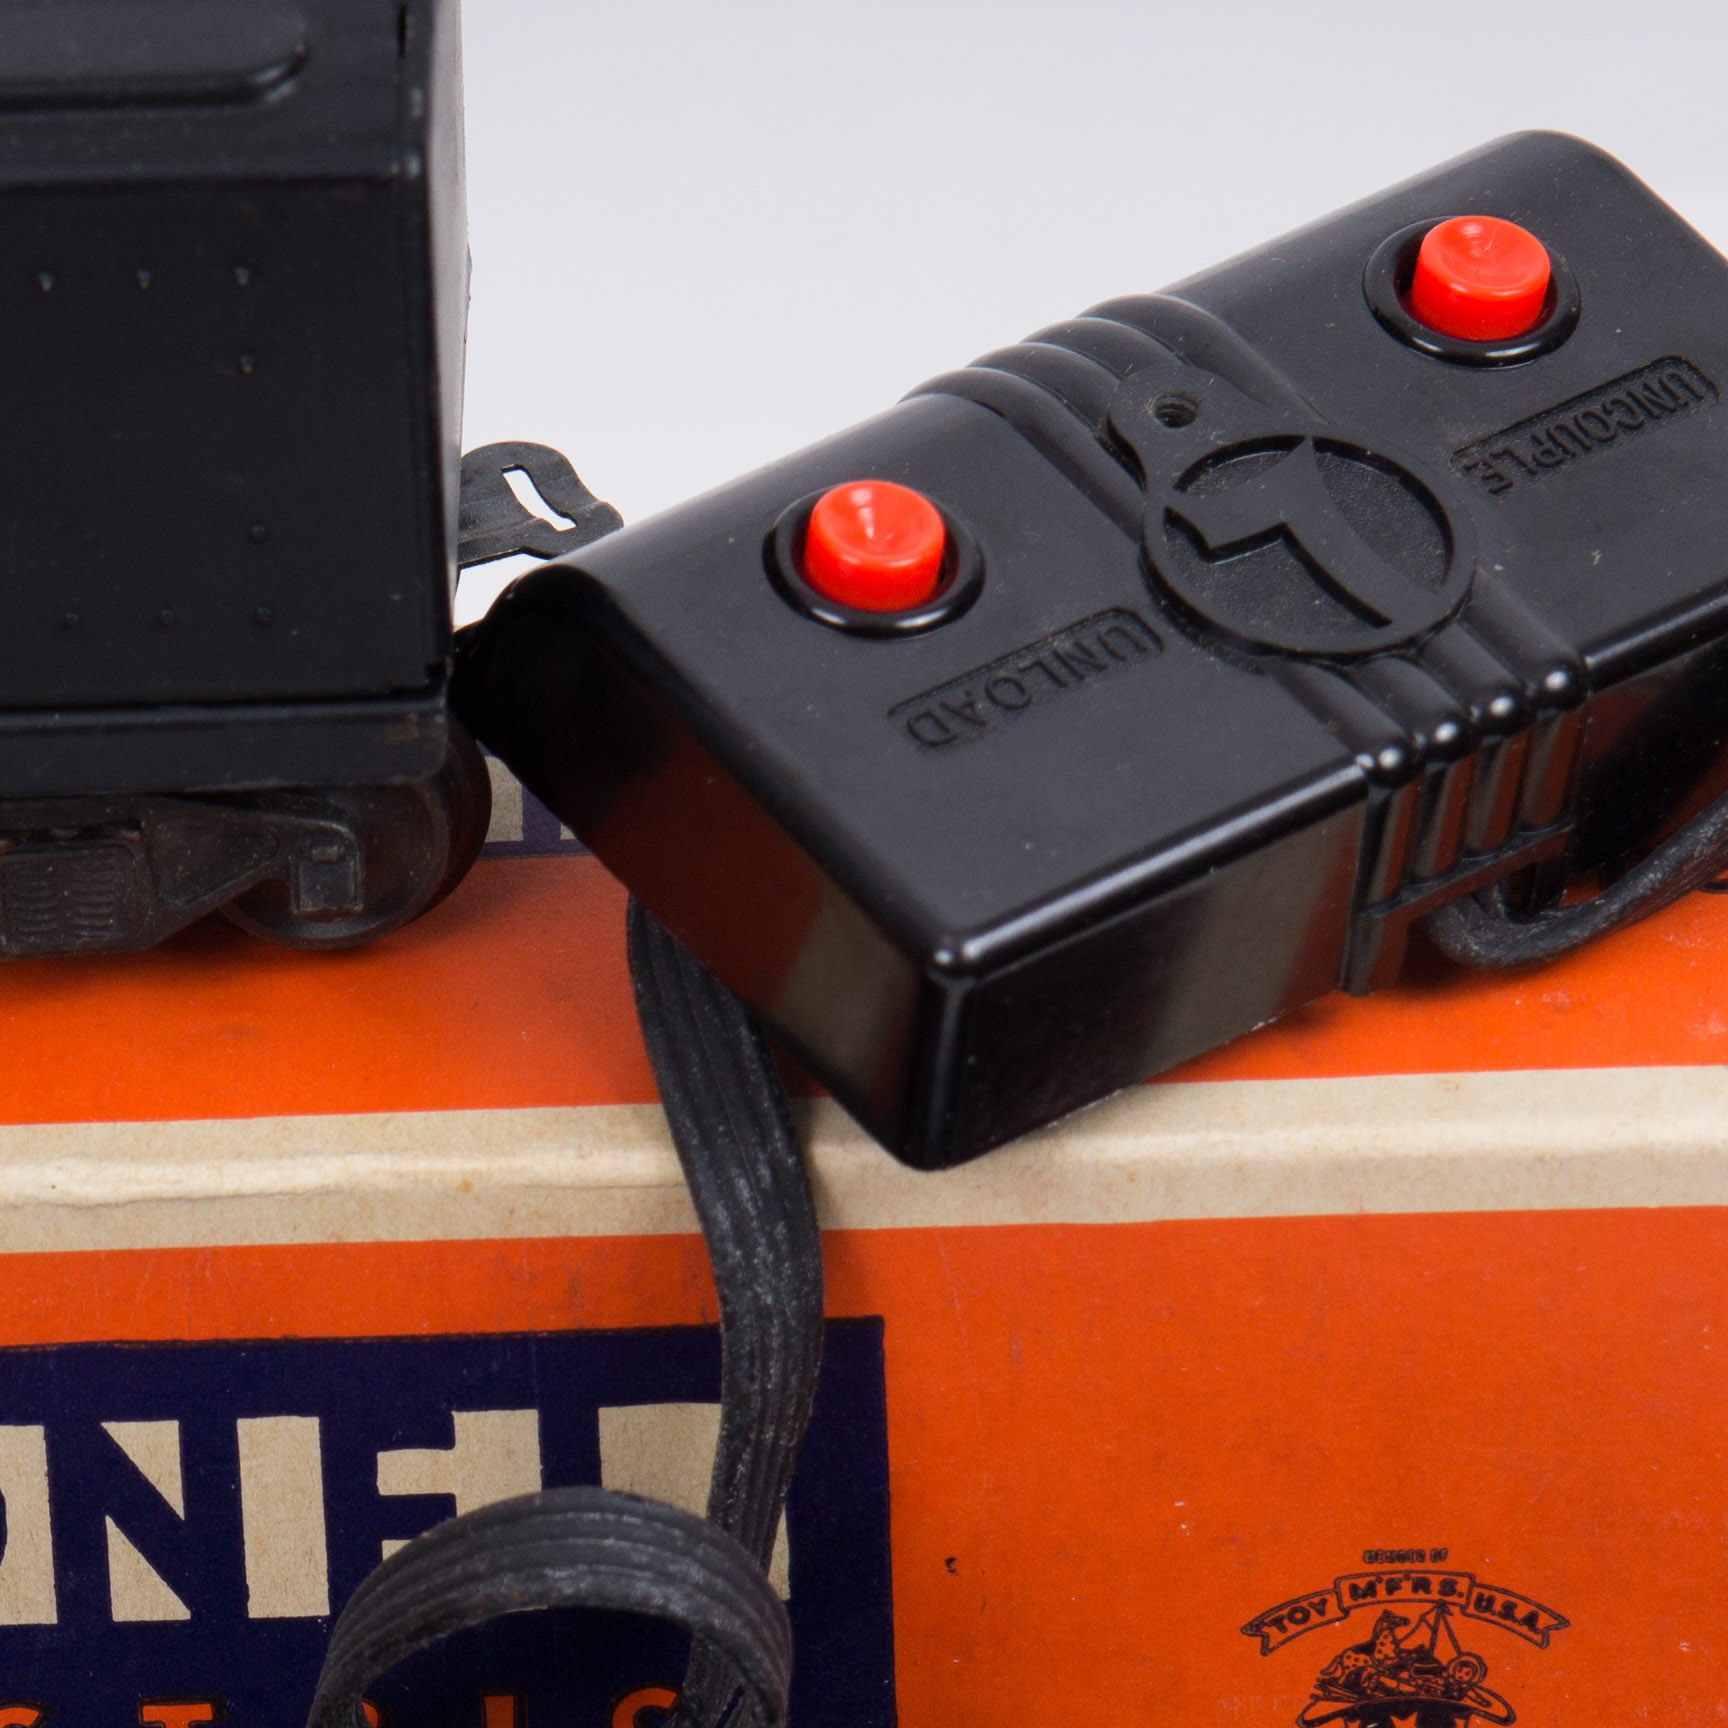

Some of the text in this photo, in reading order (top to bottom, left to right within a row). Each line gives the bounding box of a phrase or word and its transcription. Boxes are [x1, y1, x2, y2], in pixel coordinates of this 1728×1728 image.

[1463, 371, 1706, 495] UNCOUPLE
[906, 624, 1149, 747] UNLOAD
[1271, 1597, 1329, 1634] TOY
